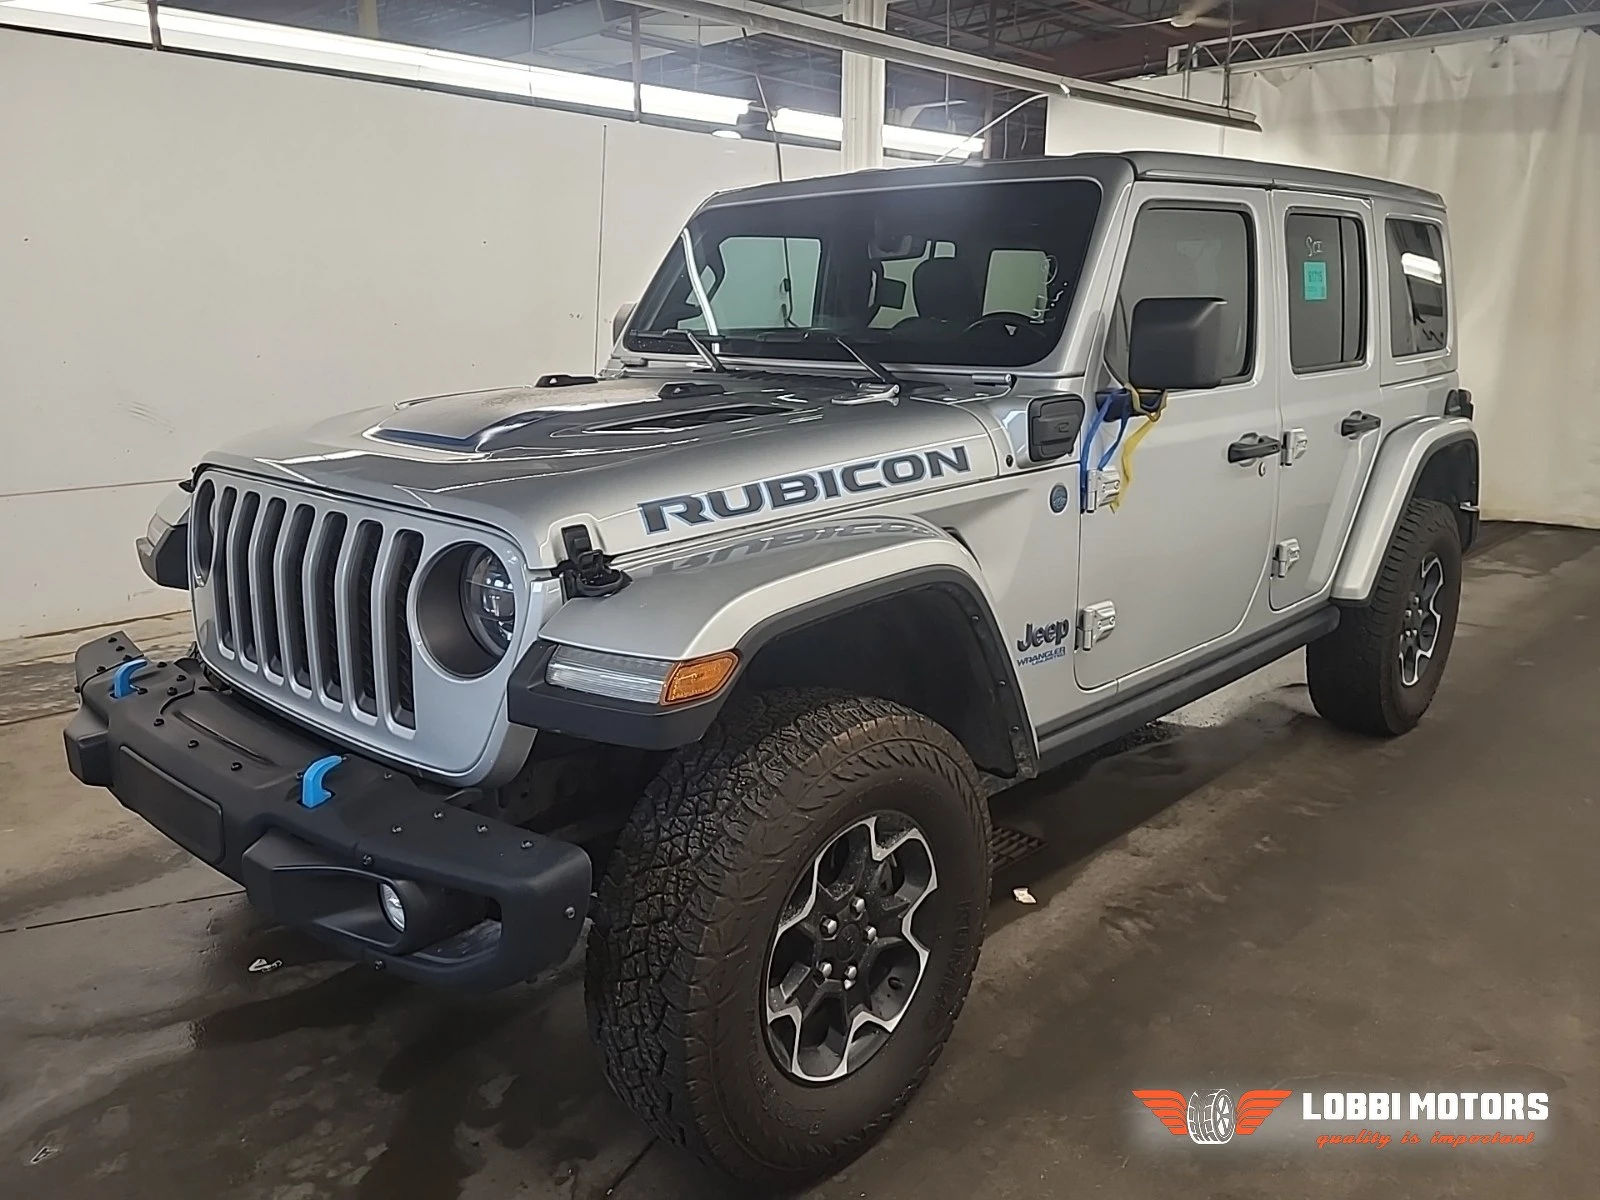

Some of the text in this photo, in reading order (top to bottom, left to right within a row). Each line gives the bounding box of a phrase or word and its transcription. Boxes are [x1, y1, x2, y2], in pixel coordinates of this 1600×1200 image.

[637, 445, 971, 535] RUBICON
[1017, 619, 1069, 652] Jeep
[1016, 646, 1066, 667] WRANGLER
